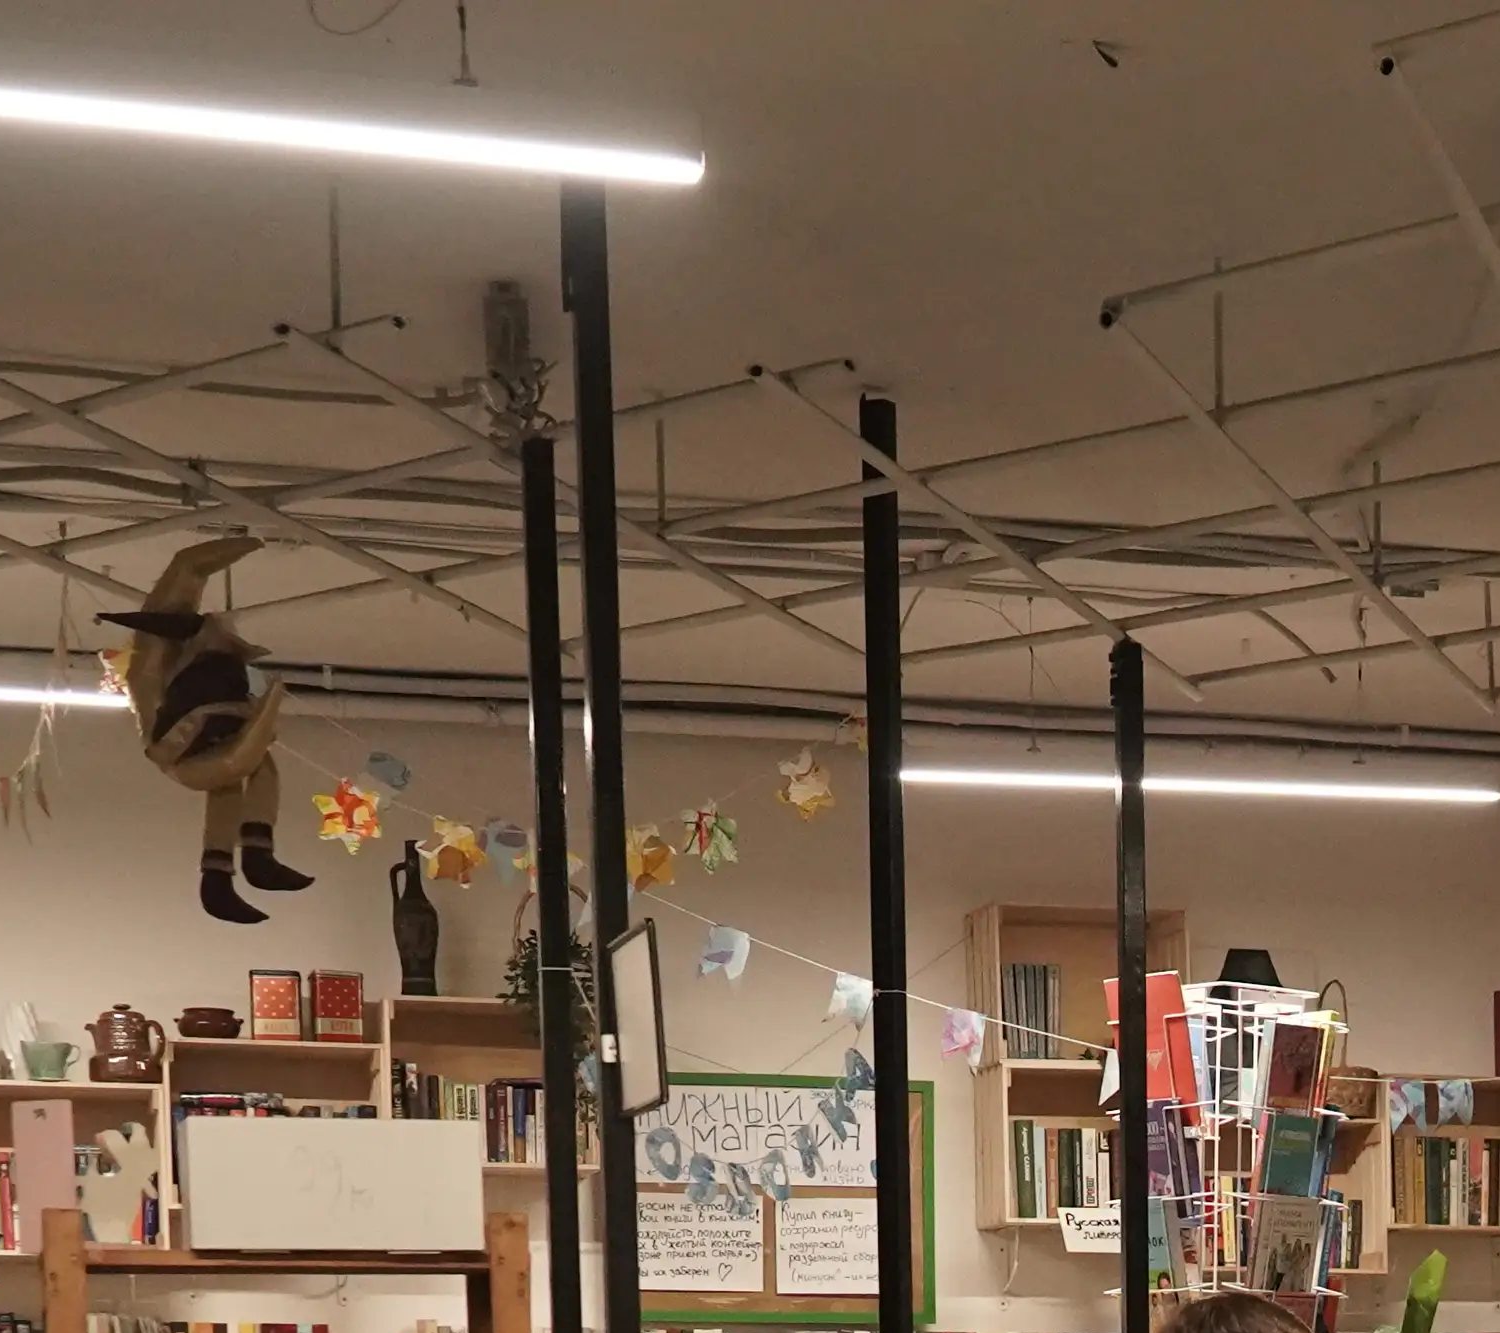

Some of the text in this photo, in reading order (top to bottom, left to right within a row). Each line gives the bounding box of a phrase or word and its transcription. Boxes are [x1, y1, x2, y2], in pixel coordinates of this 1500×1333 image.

[637, 1089, 803, 1127] НИЖНЫЙ
[639, 1210, 658, 1223] вои
[1065, 1212, 1120, 1231] Русская
